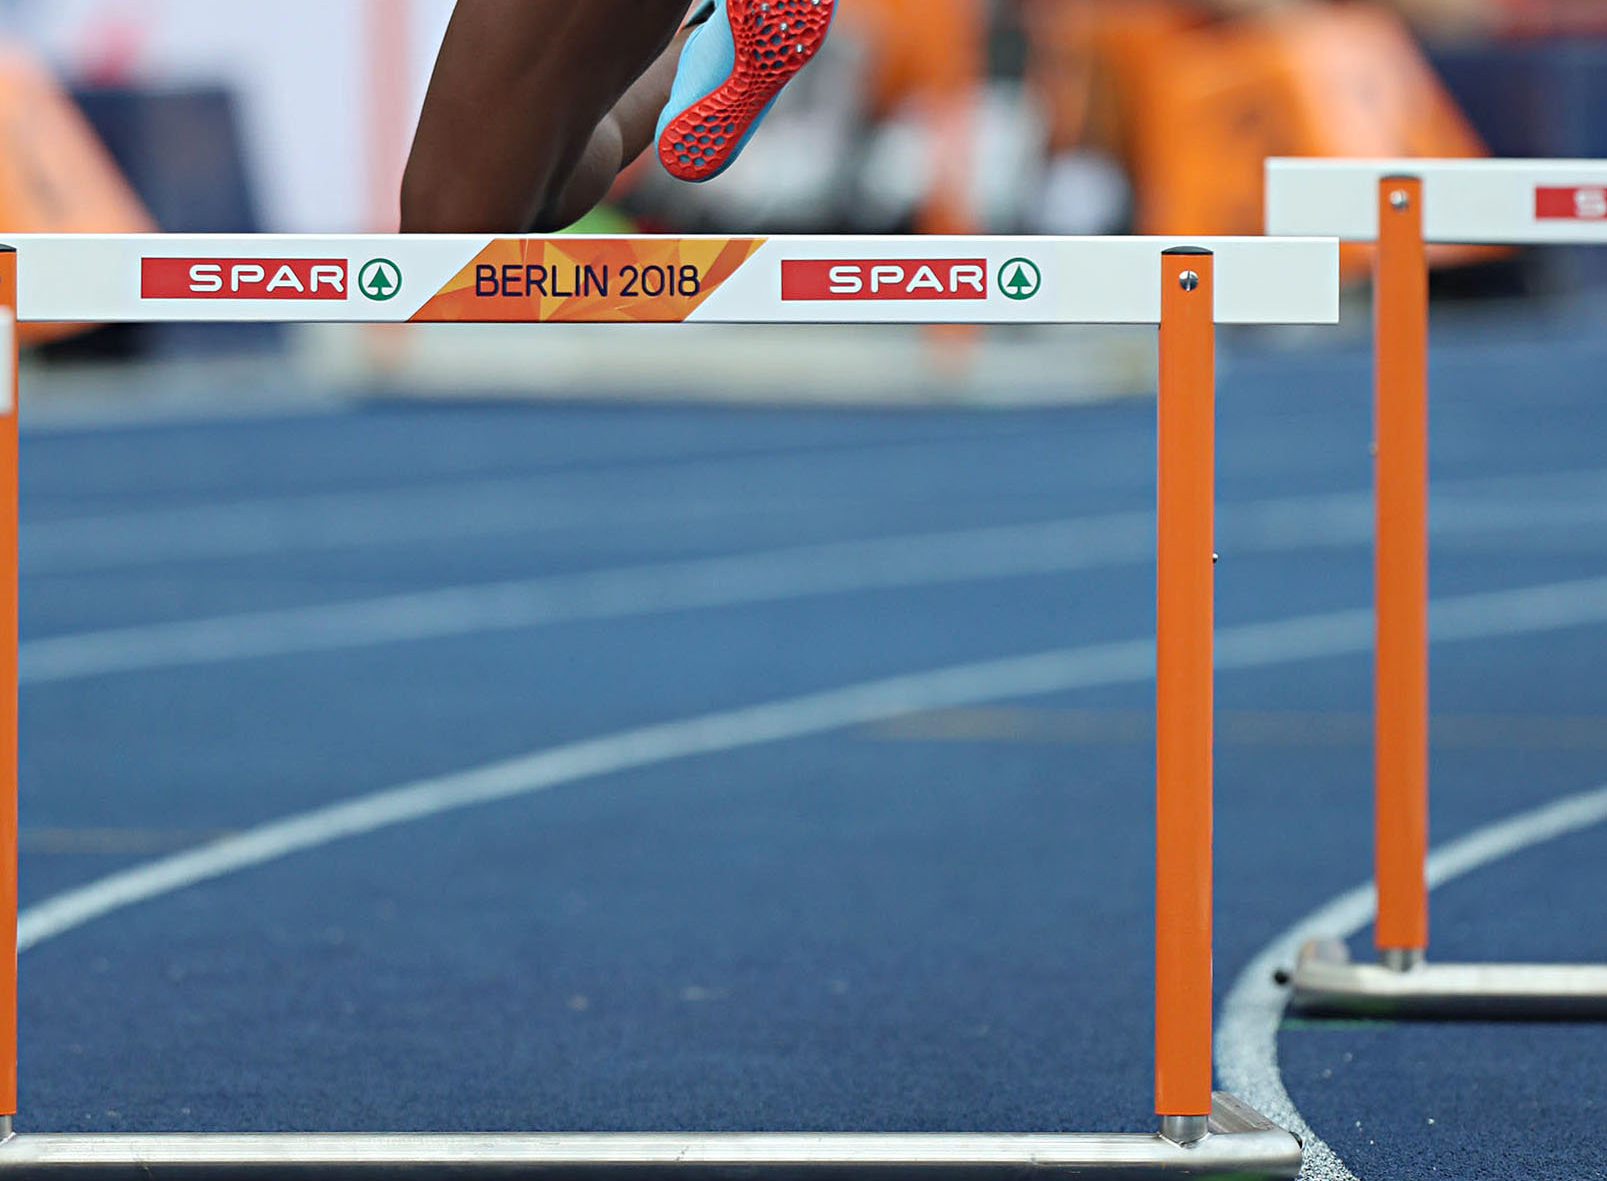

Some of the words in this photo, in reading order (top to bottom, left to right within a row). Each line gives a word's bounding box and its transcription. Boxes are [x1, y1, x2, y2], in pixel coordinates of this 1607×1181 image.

[188, 264, 344, 292] SPAR
[475, 265, 610, 297] BERLIN
[619, 265, 701, 297] 2018
[828, 265, 984, 293] SPAR
